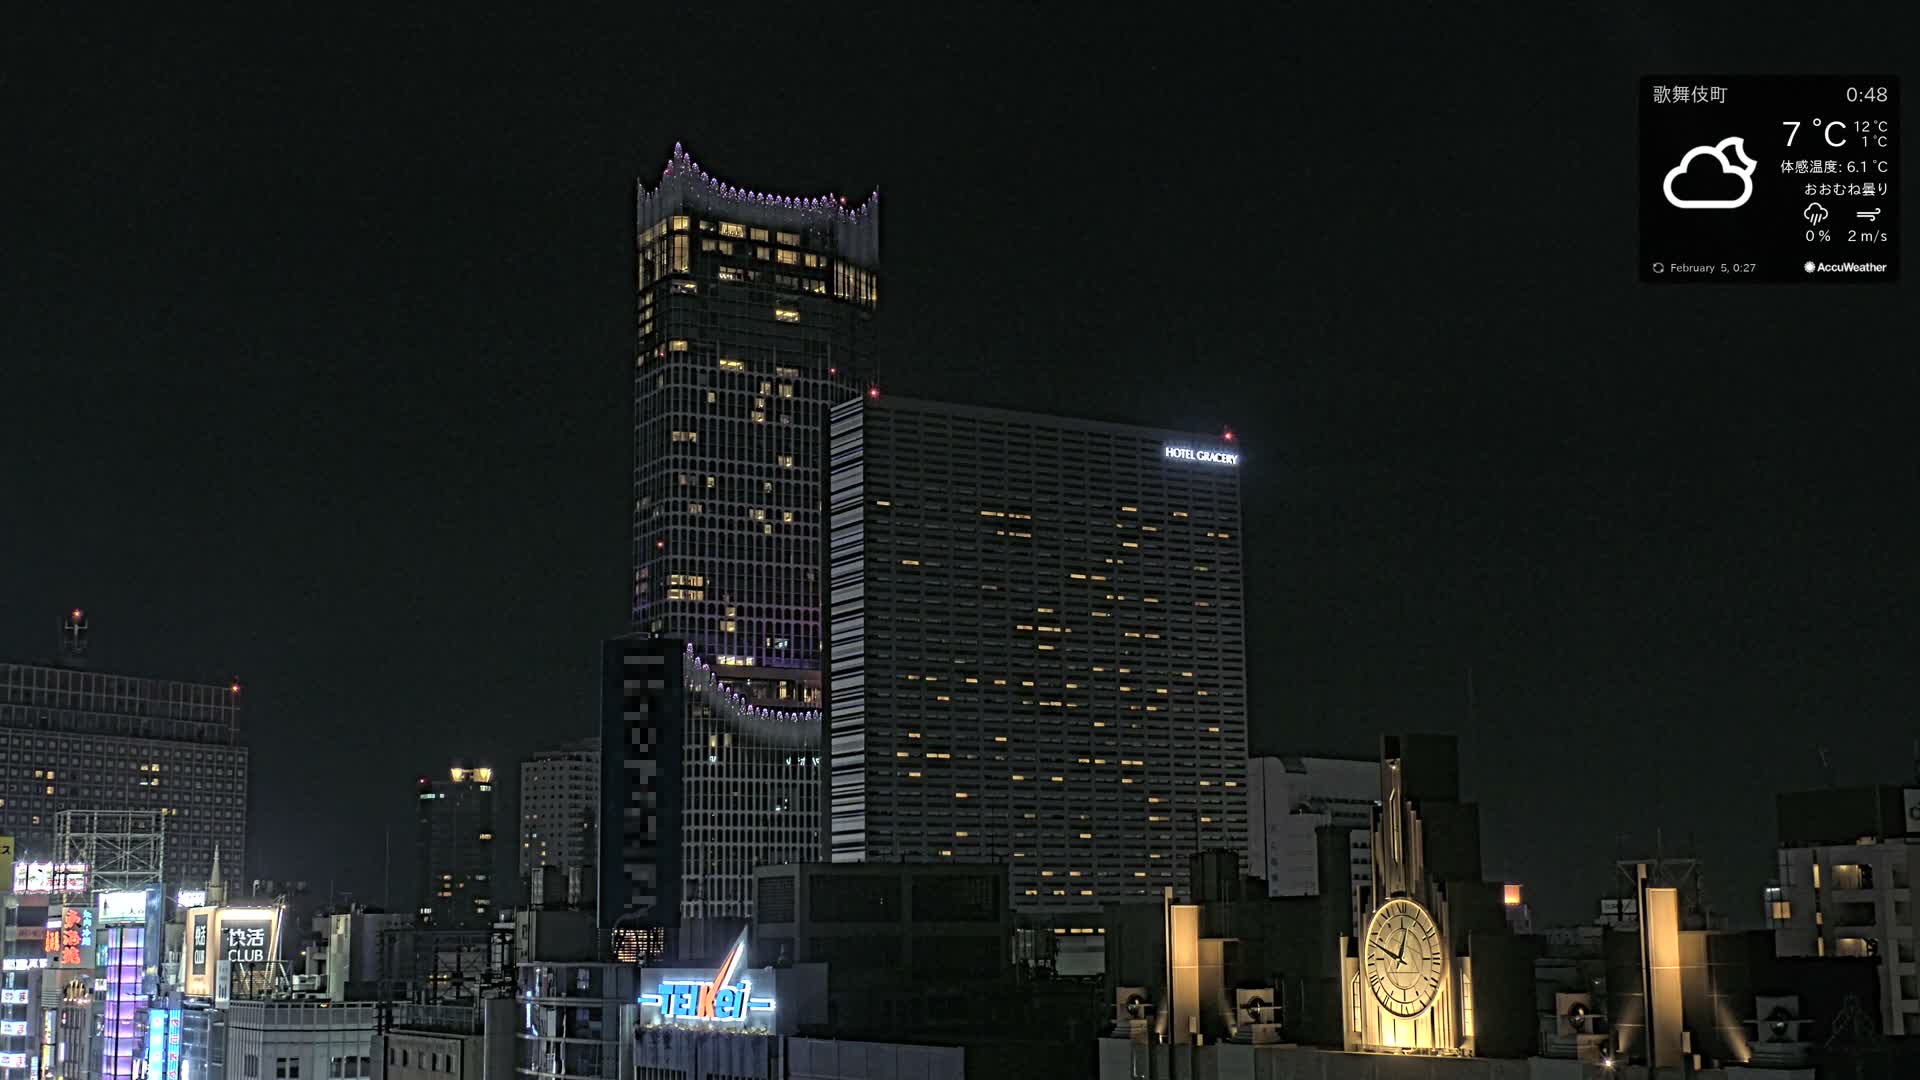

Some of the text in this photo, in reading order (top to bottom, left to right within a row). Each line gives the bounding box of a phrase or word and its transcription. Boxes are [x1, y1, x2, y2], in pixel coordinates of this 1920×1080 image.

[1165, 447, 1239, 465] HOTEL GRACERY
[227, 928, 265, 947] 快活
[228, 949, 264, 962] CLUB
